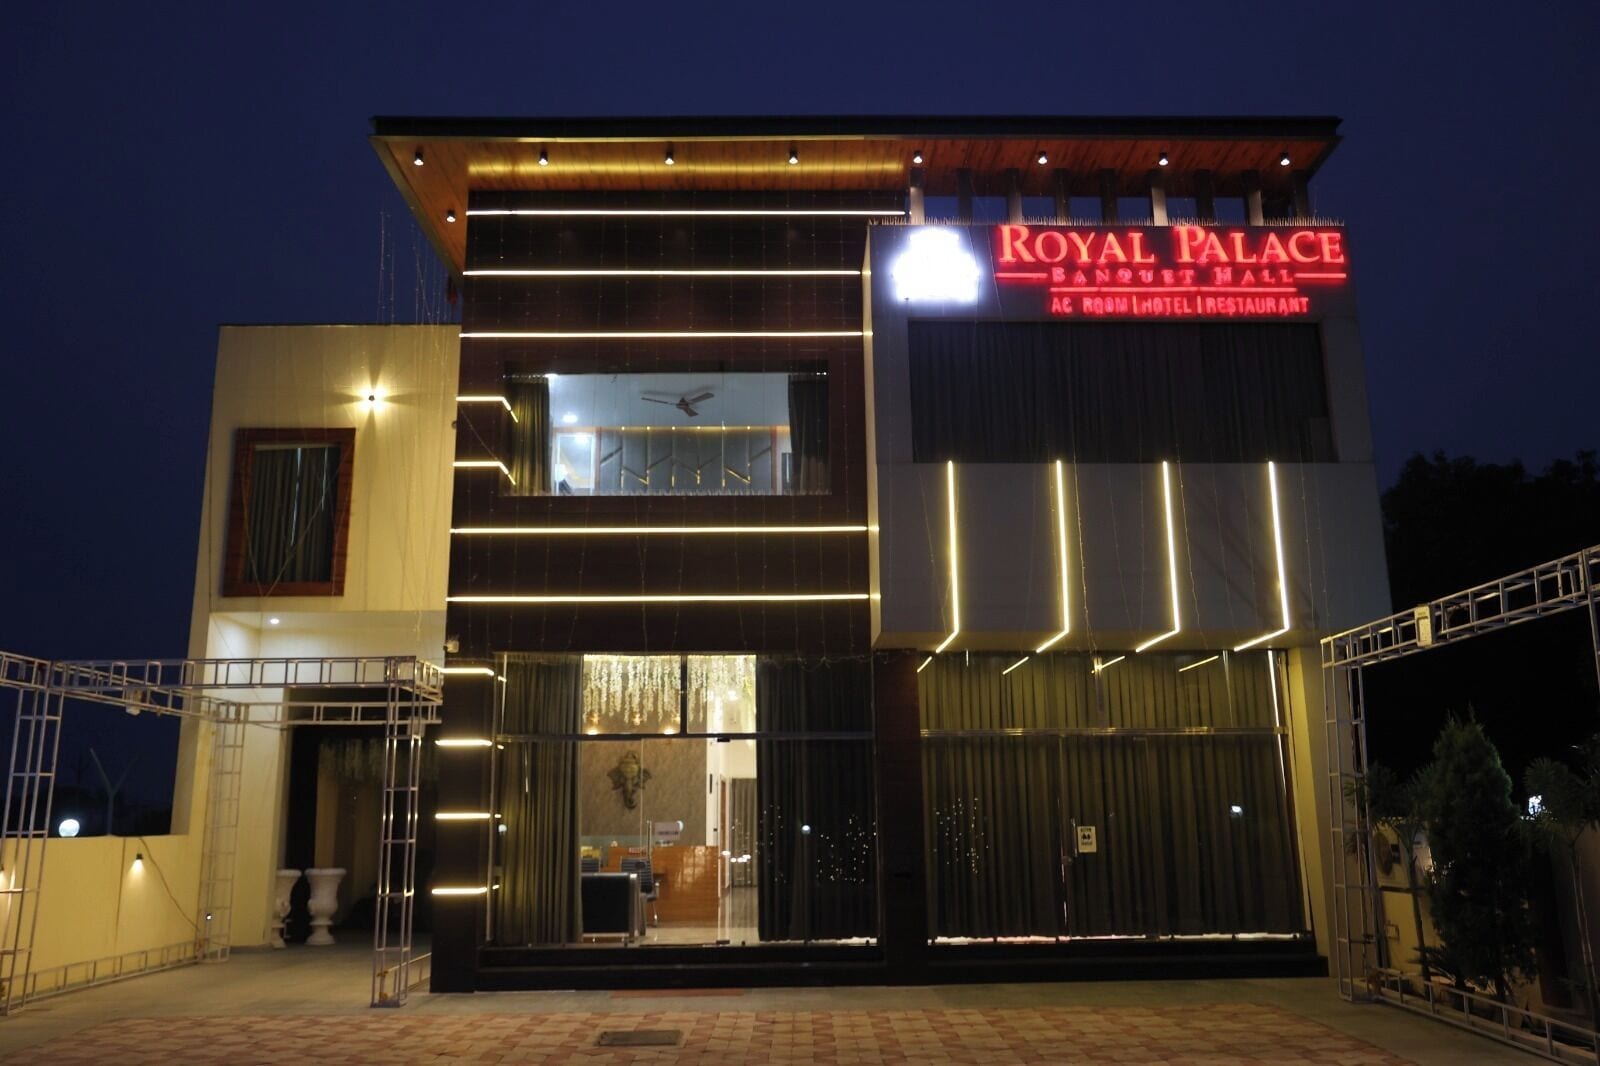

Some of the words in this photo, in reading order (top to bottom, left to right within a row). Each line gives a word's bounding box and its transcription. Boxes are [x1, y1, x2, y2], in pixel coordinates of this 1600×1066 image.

[998, 224, 1155, 264] ROYAL
[1173, 225, 1345, 264] PALACE
[1051, 266, 1195, 285] BANQUET
[1214, 266, 1294, 285] HALL
[1051, 297, 1073, 314] AC
[1082, 297, 1129, 314] ROOM
[1141, 297, 1193, 314] HOTEL
[1205, 296, 1309, 314] RESTAURANT
